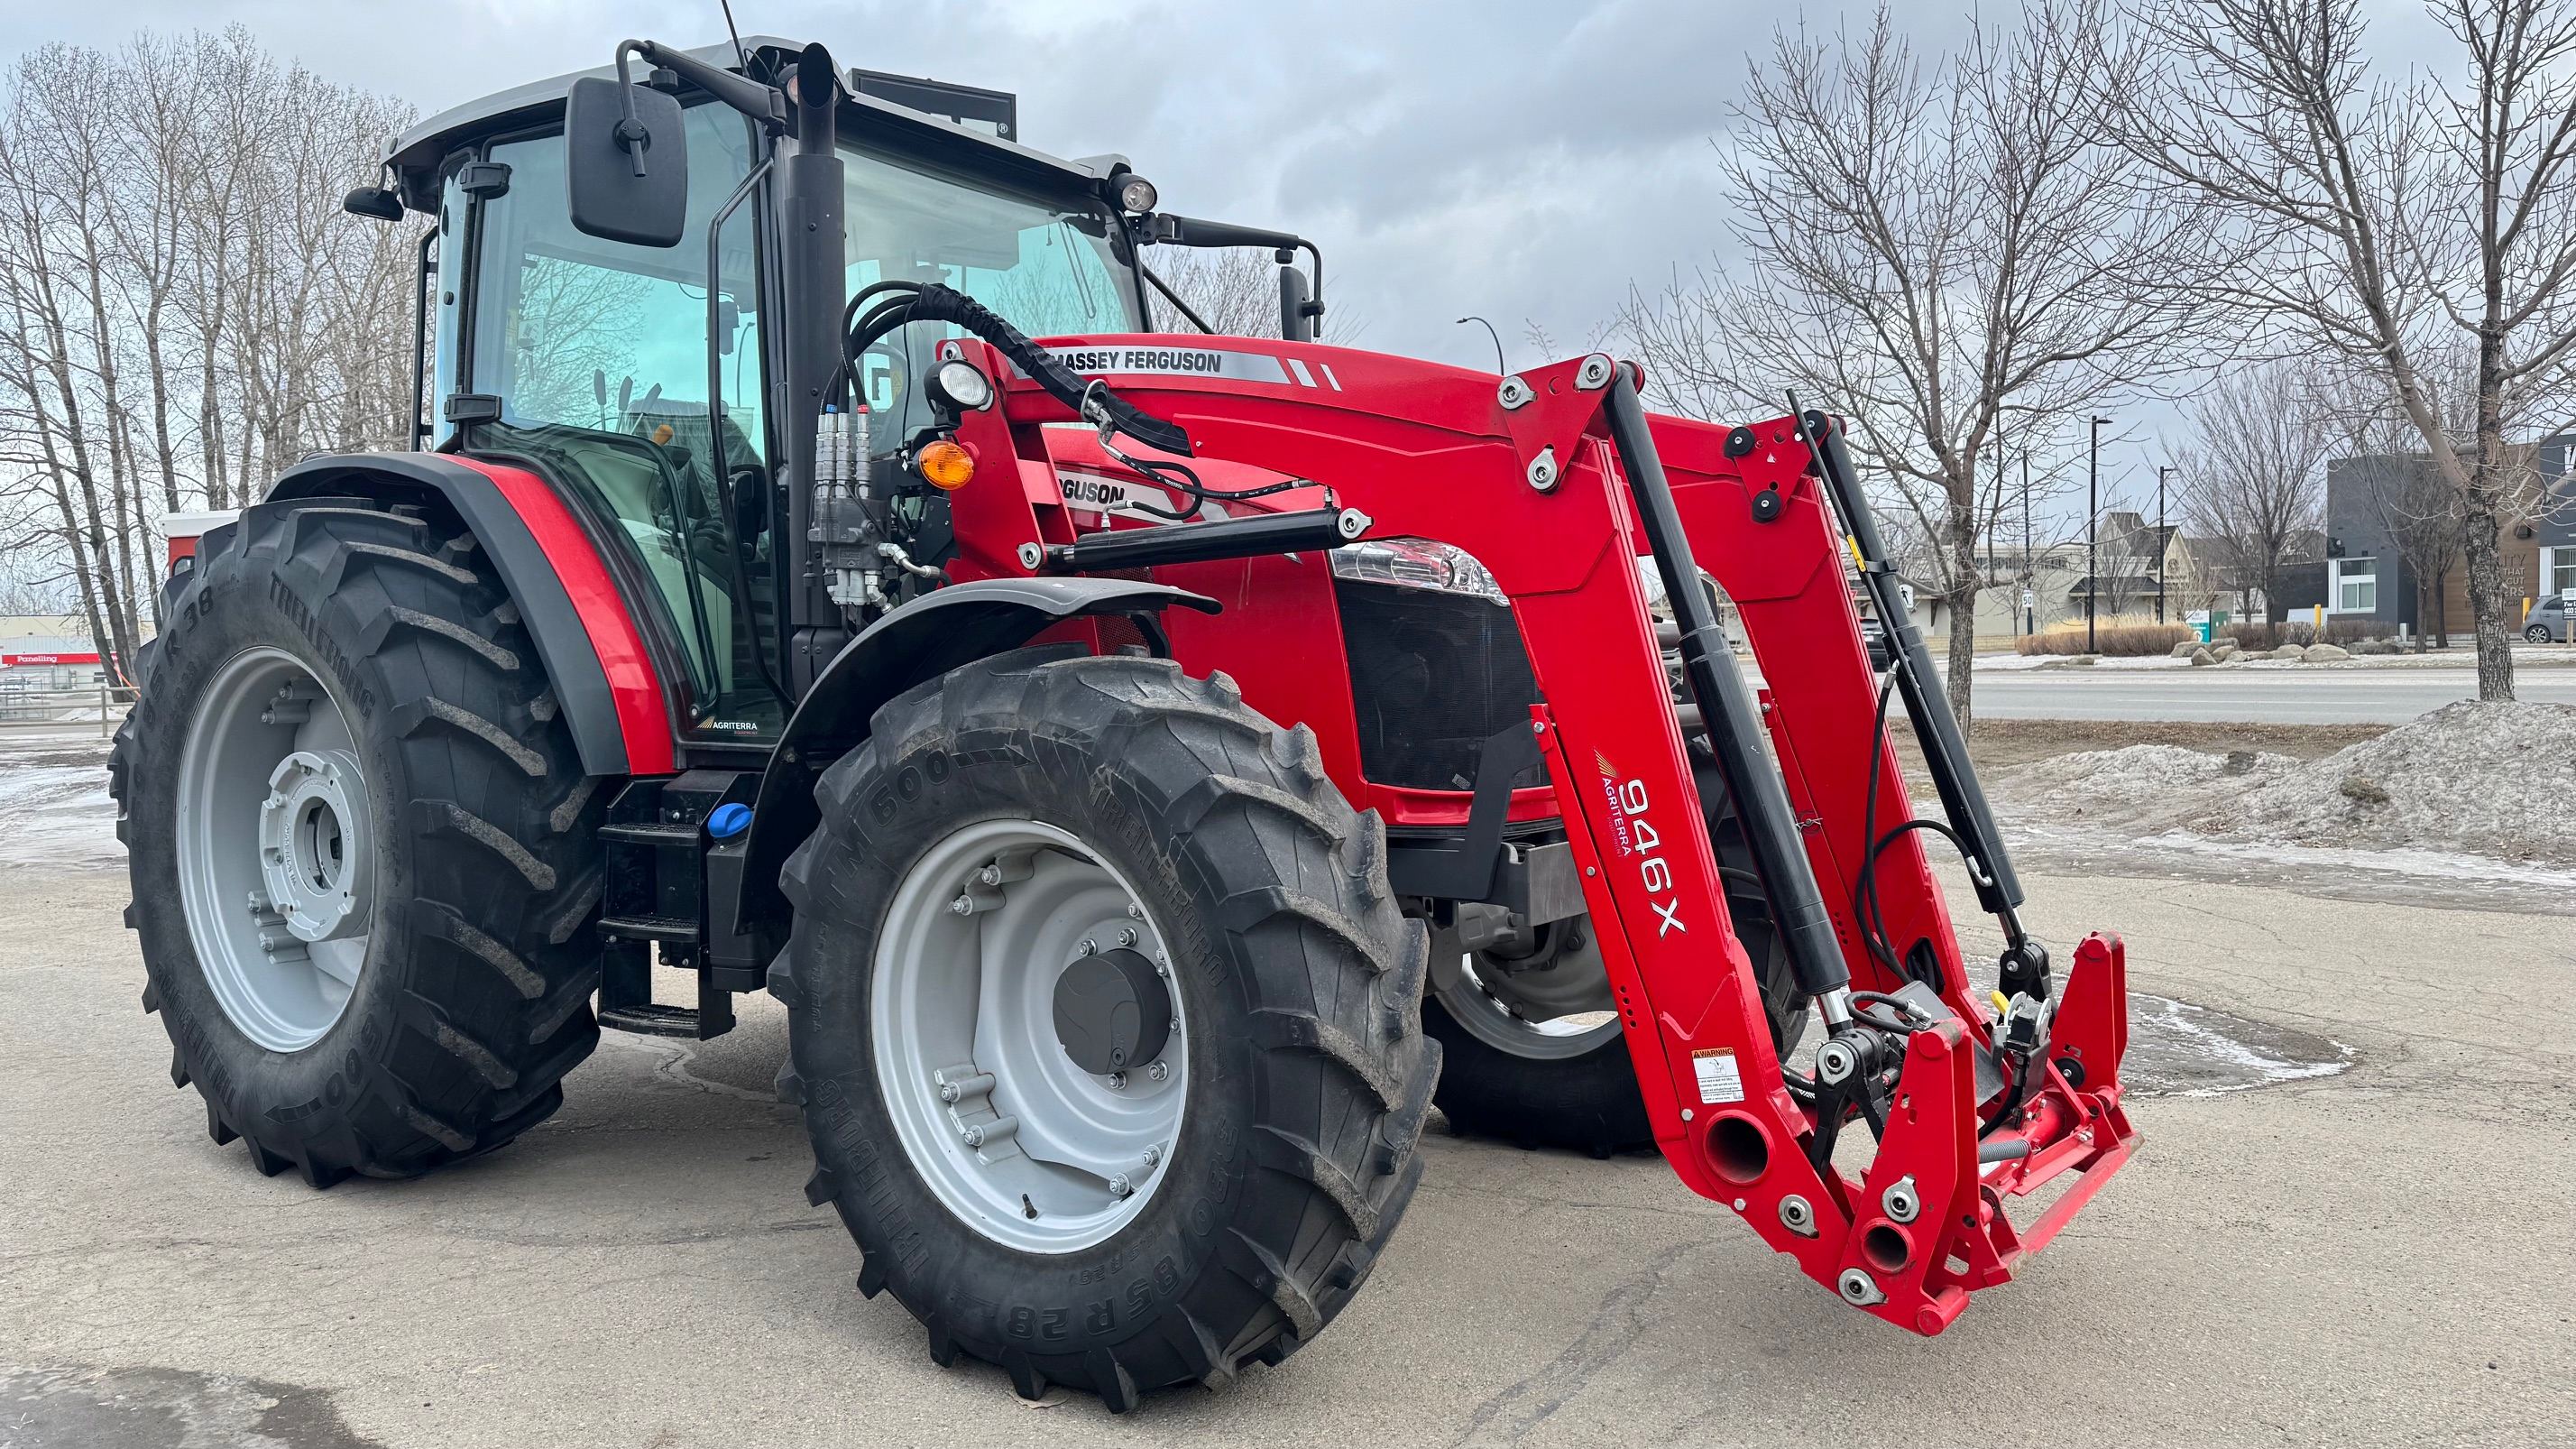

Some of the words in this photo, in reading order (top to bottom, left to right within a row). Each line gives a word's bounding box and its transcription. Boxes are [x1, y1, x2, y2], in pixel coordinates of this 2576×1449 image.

[1124, 351, 1221, 373] FERGUSON
[2503, 567, 2525, 576] THAT
[2506, 577, 2525, 586] CUT
[183, 586, 214, 634] 38
[2023, 595, 2032, 605] 50
[17, 655, 58, 663] Panelling
[713, 721, 758, 730] AGRITERRA
[868, 749, 952, 829] 600
[1602, 777, 1632, 857] AGRITERRA
[1700, 1048, 1734, 1057] WARNING
[814, 1078, 931, 1280] TRELLEBORG
[1007, 1306, 1070, 1342] 28
[1085, 1297, 1118, 1337] R
